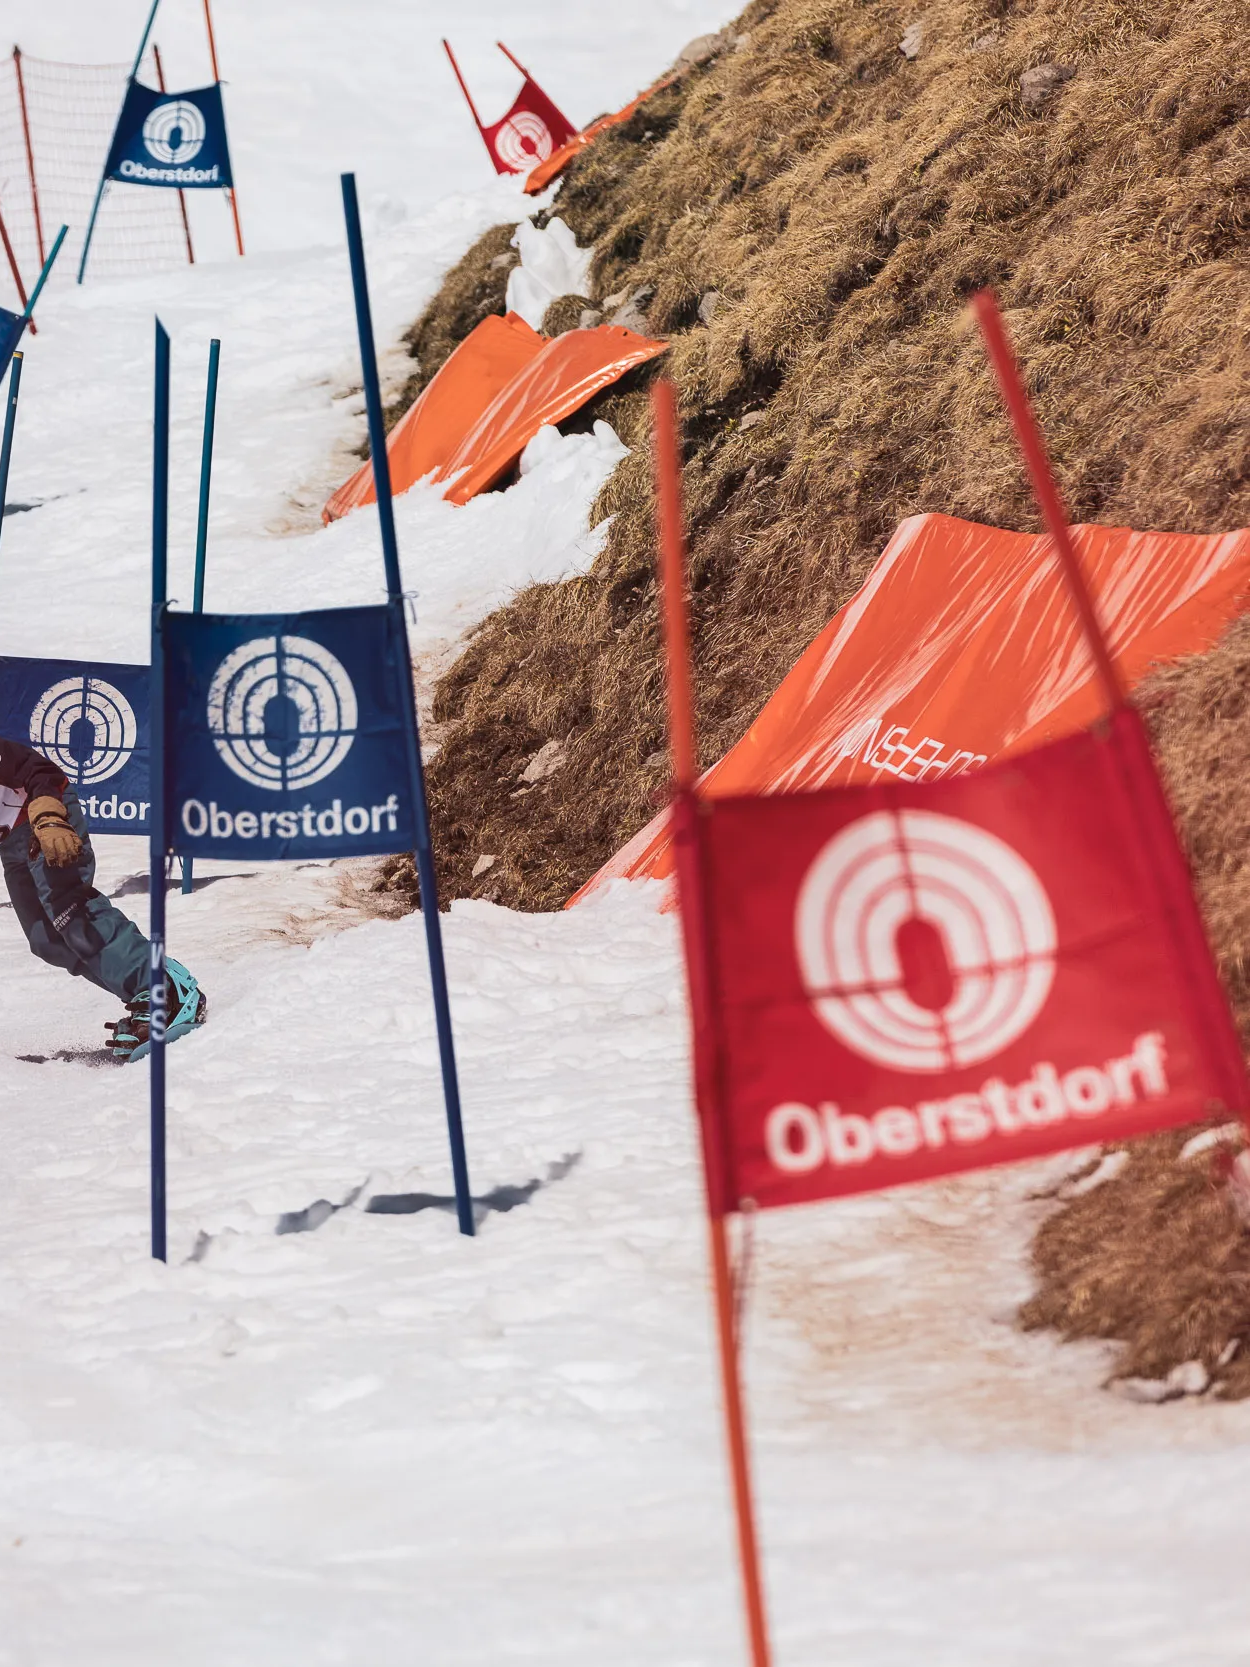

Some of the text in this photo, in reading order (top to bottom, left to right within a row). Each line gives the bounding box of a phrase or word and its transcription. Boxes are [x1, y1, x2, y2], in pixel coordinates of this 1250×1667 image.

[119, 160, 219, 184] Oberstdorf
[181, 793, 398, 839] Oberstdorf
[763, 1031, 1170, 1174] Oberstdorf
